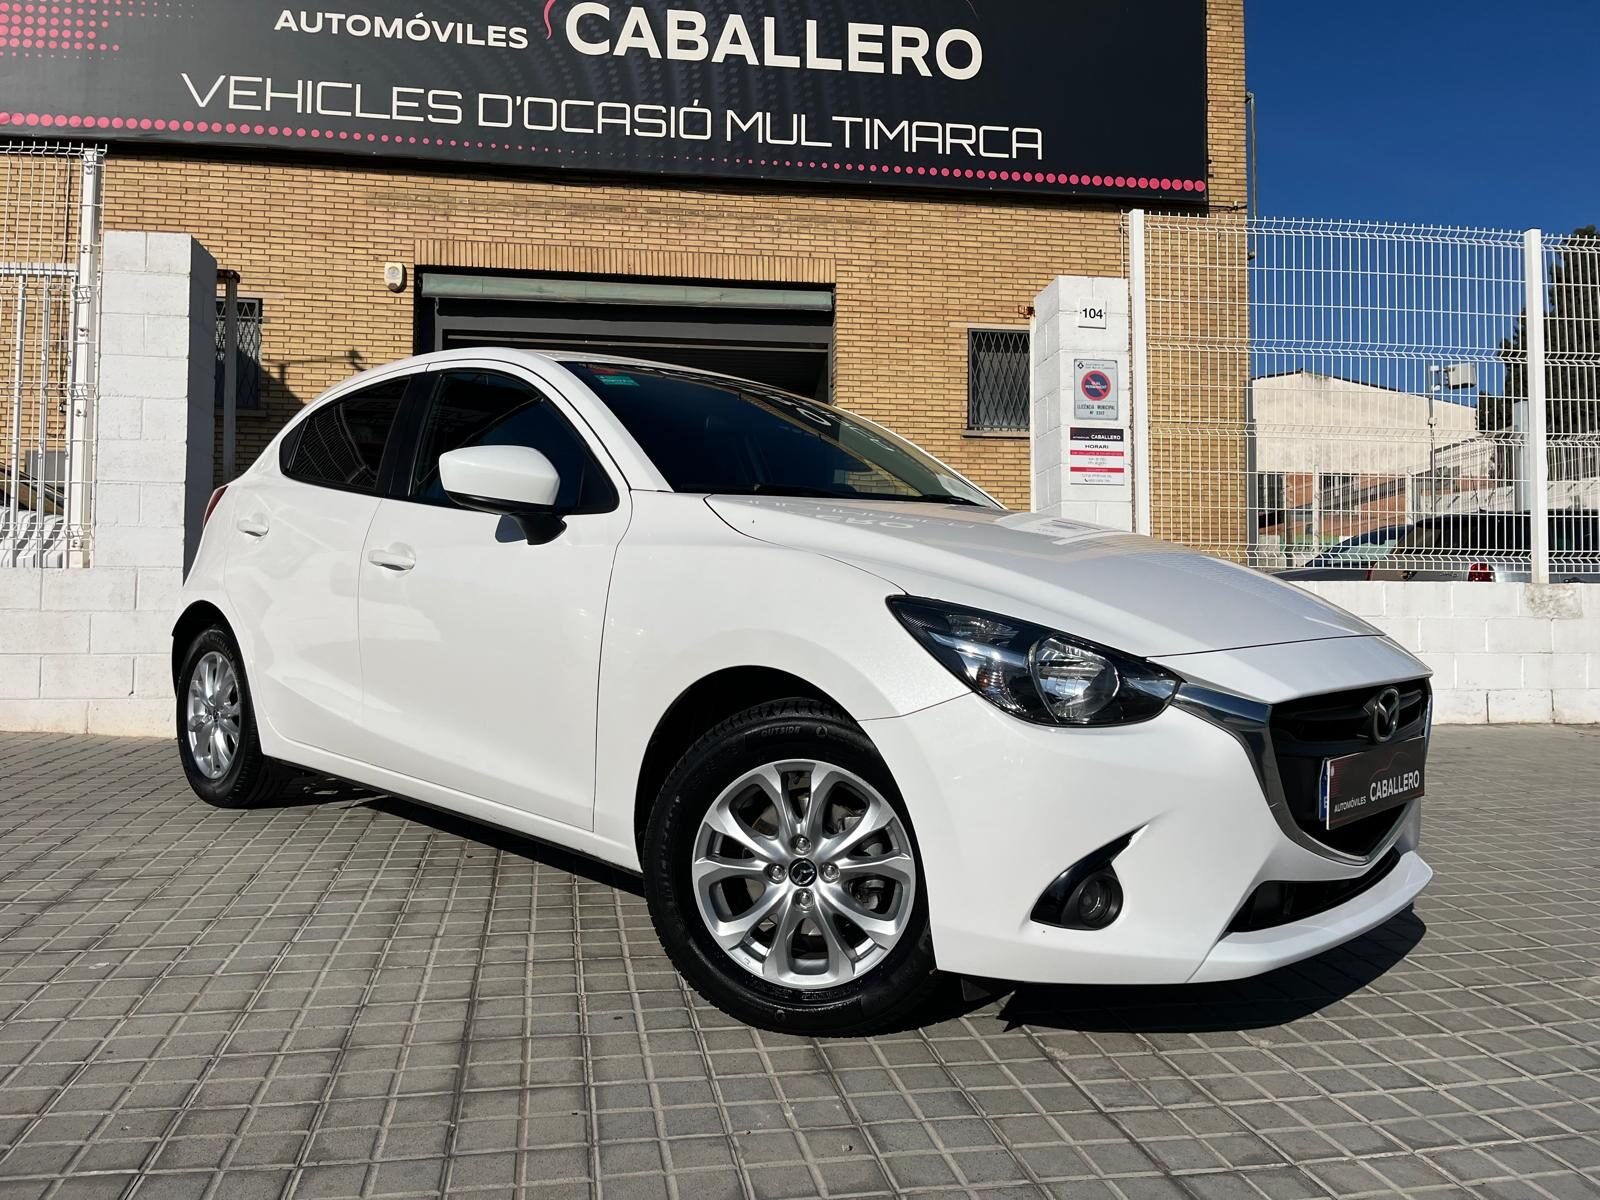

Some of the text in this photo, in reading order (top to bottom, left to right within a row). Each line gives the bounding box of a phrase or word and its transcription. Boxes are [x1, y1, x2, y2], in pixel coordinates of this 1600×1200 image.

[273, 1, 983, 80] AUTOMÓVILES CABALLERO
[180, 72, 463, 125] VEHICLES
[726, 109, 1044, 160] MULTIMARCA
[1082, 308, 1103, 319] 104
[1334, 769, 1420, 813] AUTOMÓVILES CABALLERO
